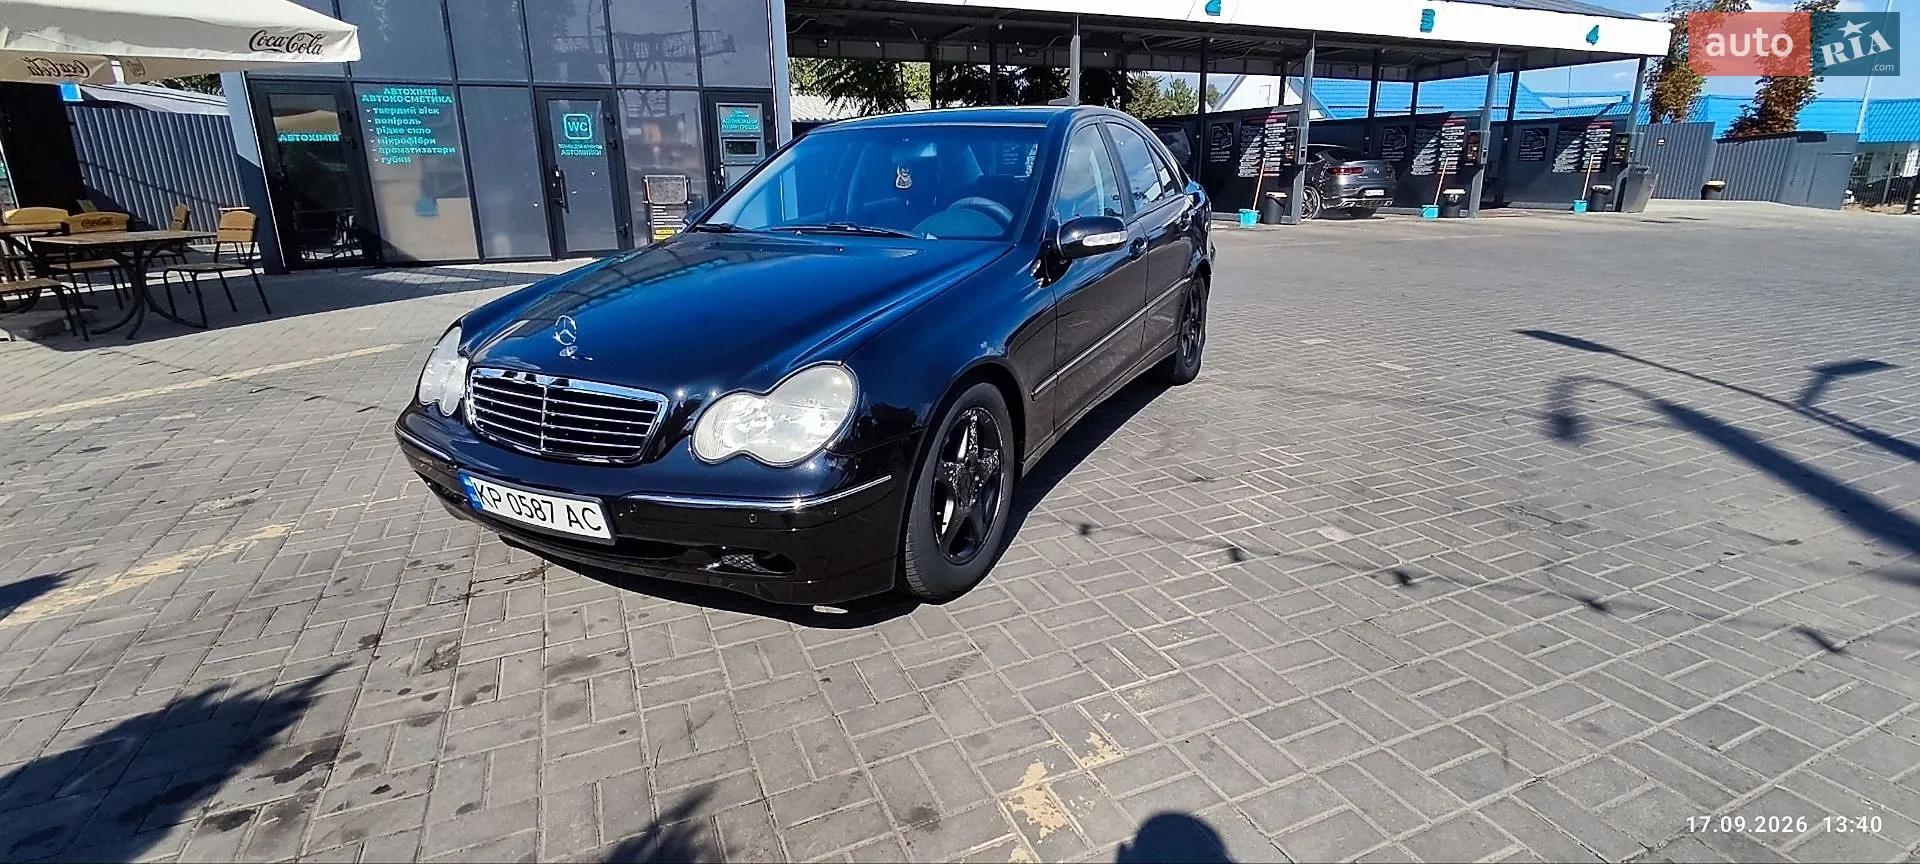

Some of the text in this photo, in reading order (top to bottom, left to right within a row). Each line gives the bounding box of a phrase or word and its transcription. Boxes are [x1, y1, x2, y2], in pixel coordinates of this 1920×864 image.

[383, 88, 437, 96] АВТОХІМІЯ
[361, 94, 453, 103] АВТОКОСМЕТИКА
[568, 121, 588, 131] WC
[278, 133, 340, 142] АВТОХІМІЯ
[379, 147, 456, 155] ароматизатори
[473, 482, 602, 531] KP 0587 AC
